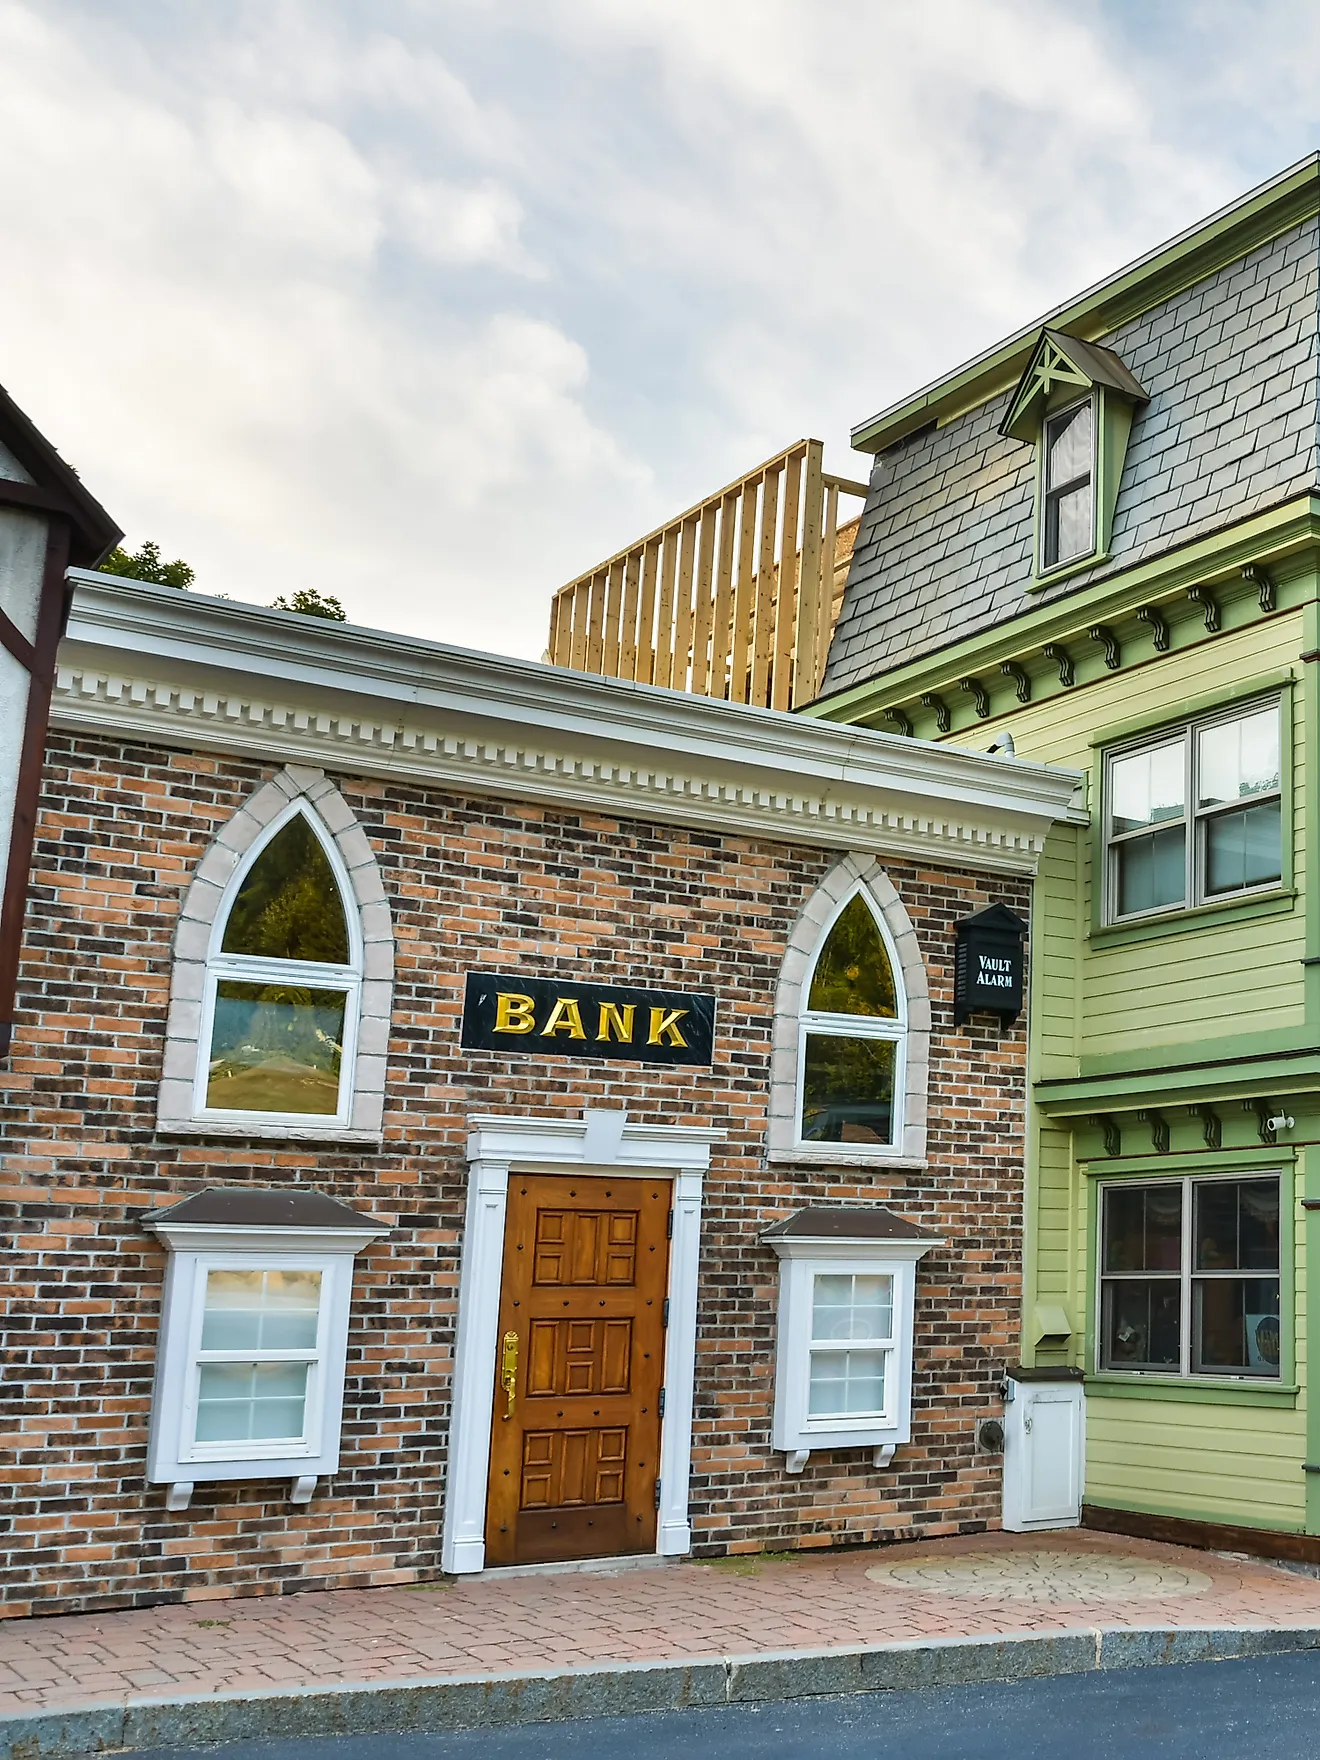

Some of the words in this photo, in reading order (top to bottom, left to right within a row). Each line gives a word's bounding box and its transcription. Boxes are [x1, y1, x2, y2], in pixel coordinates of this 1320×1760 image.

[978, 955, 1012, 972] VAULT
[976, 971, 1013, 988] ALARM
[492, 991, 690, 1048] BANK
